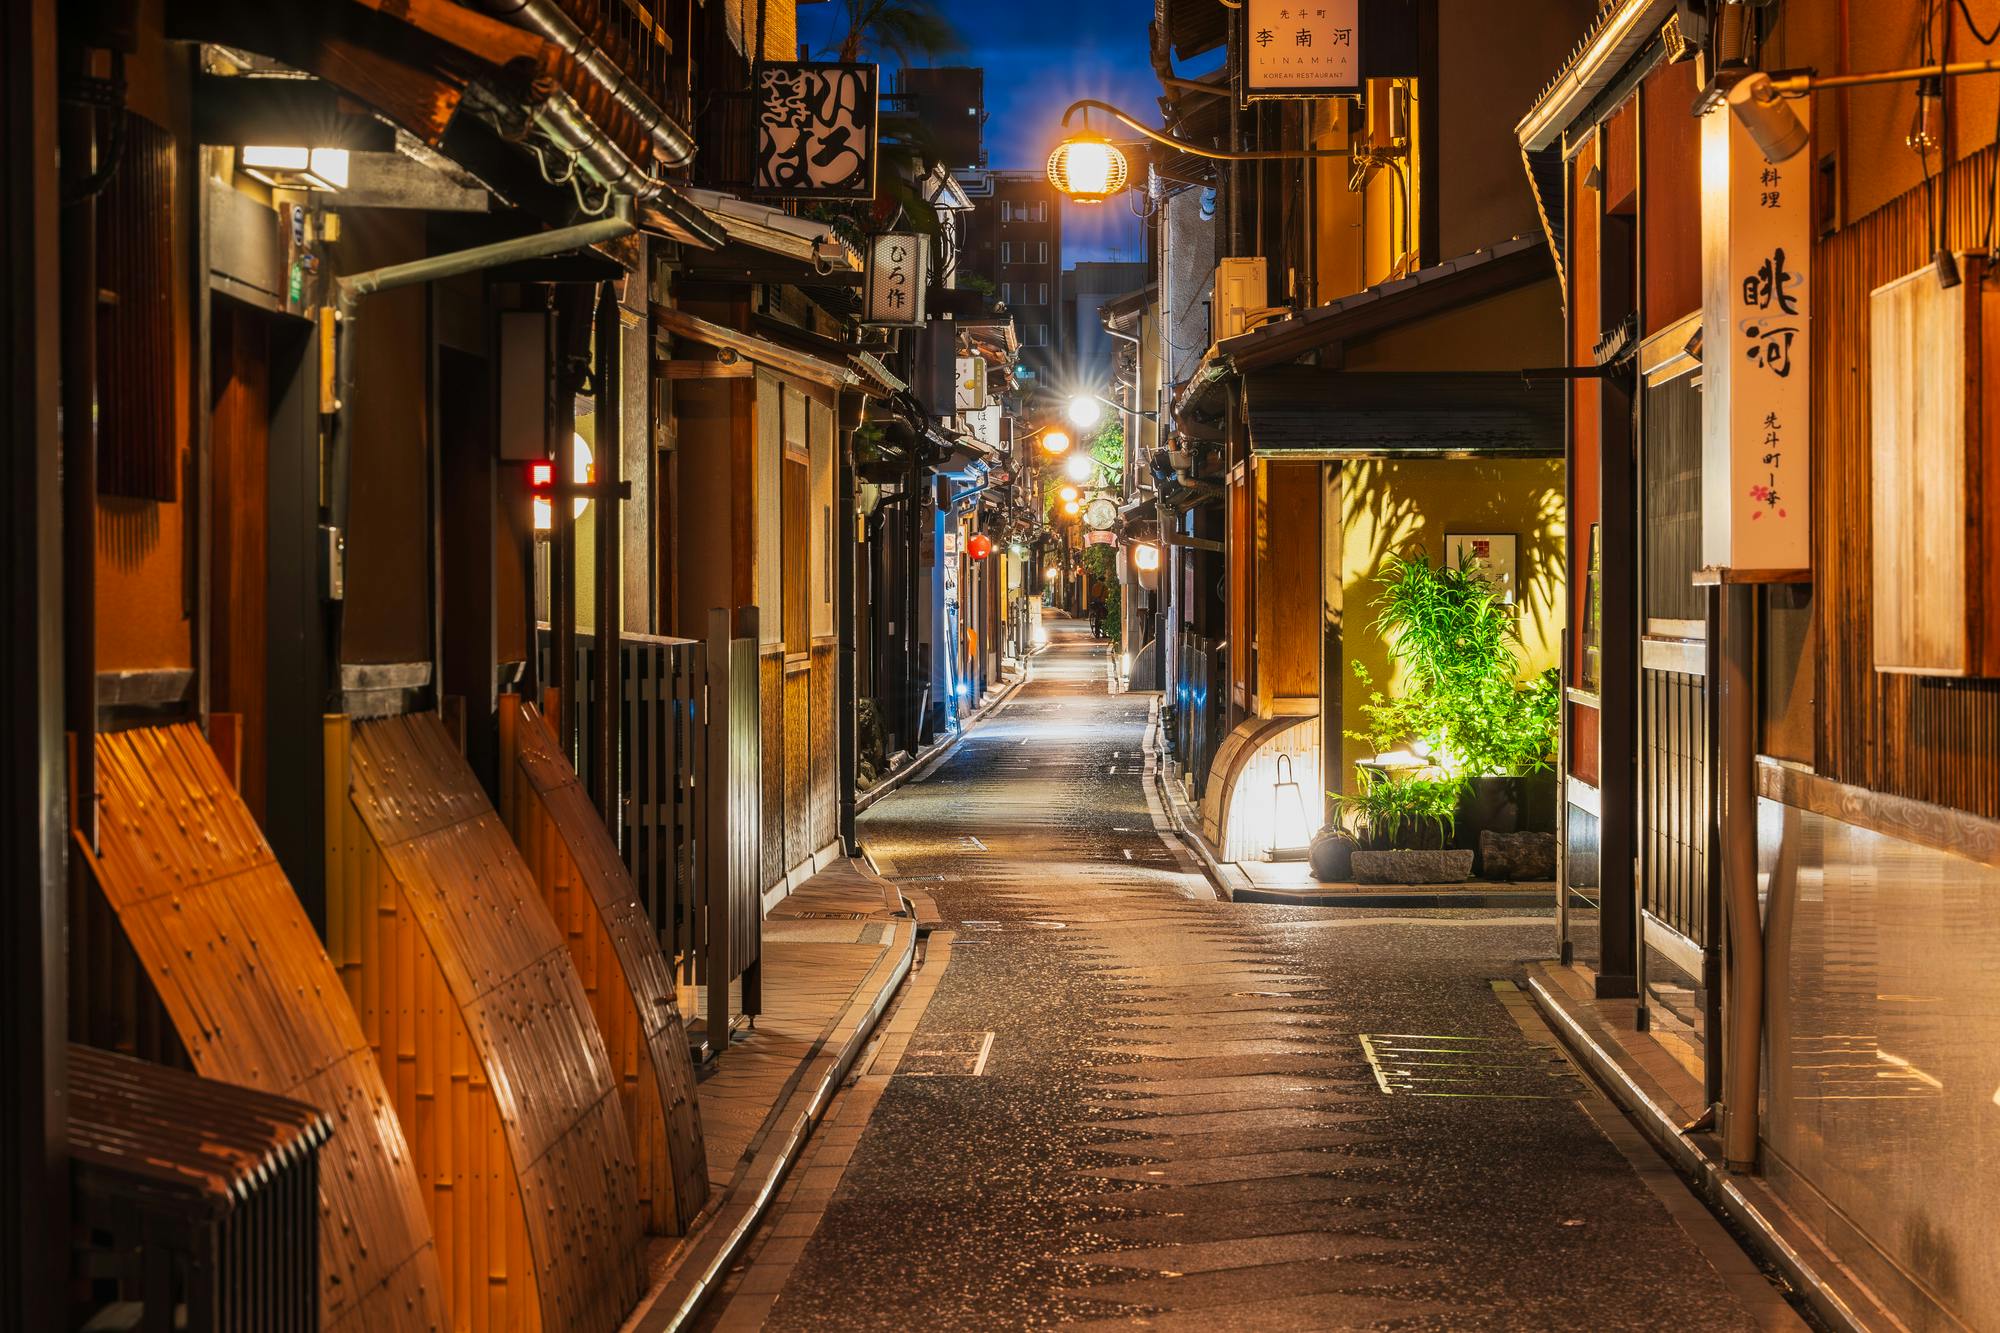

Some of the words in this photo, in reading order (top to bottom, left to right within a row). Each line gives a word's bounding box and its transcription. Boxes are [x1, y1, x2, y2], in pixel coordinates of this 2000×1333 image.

[1280, 9, 1327, 19] 先斗町
[1255, 28, 1352, 47] 李南河
[887, 245, 906, 308] ひろ作
